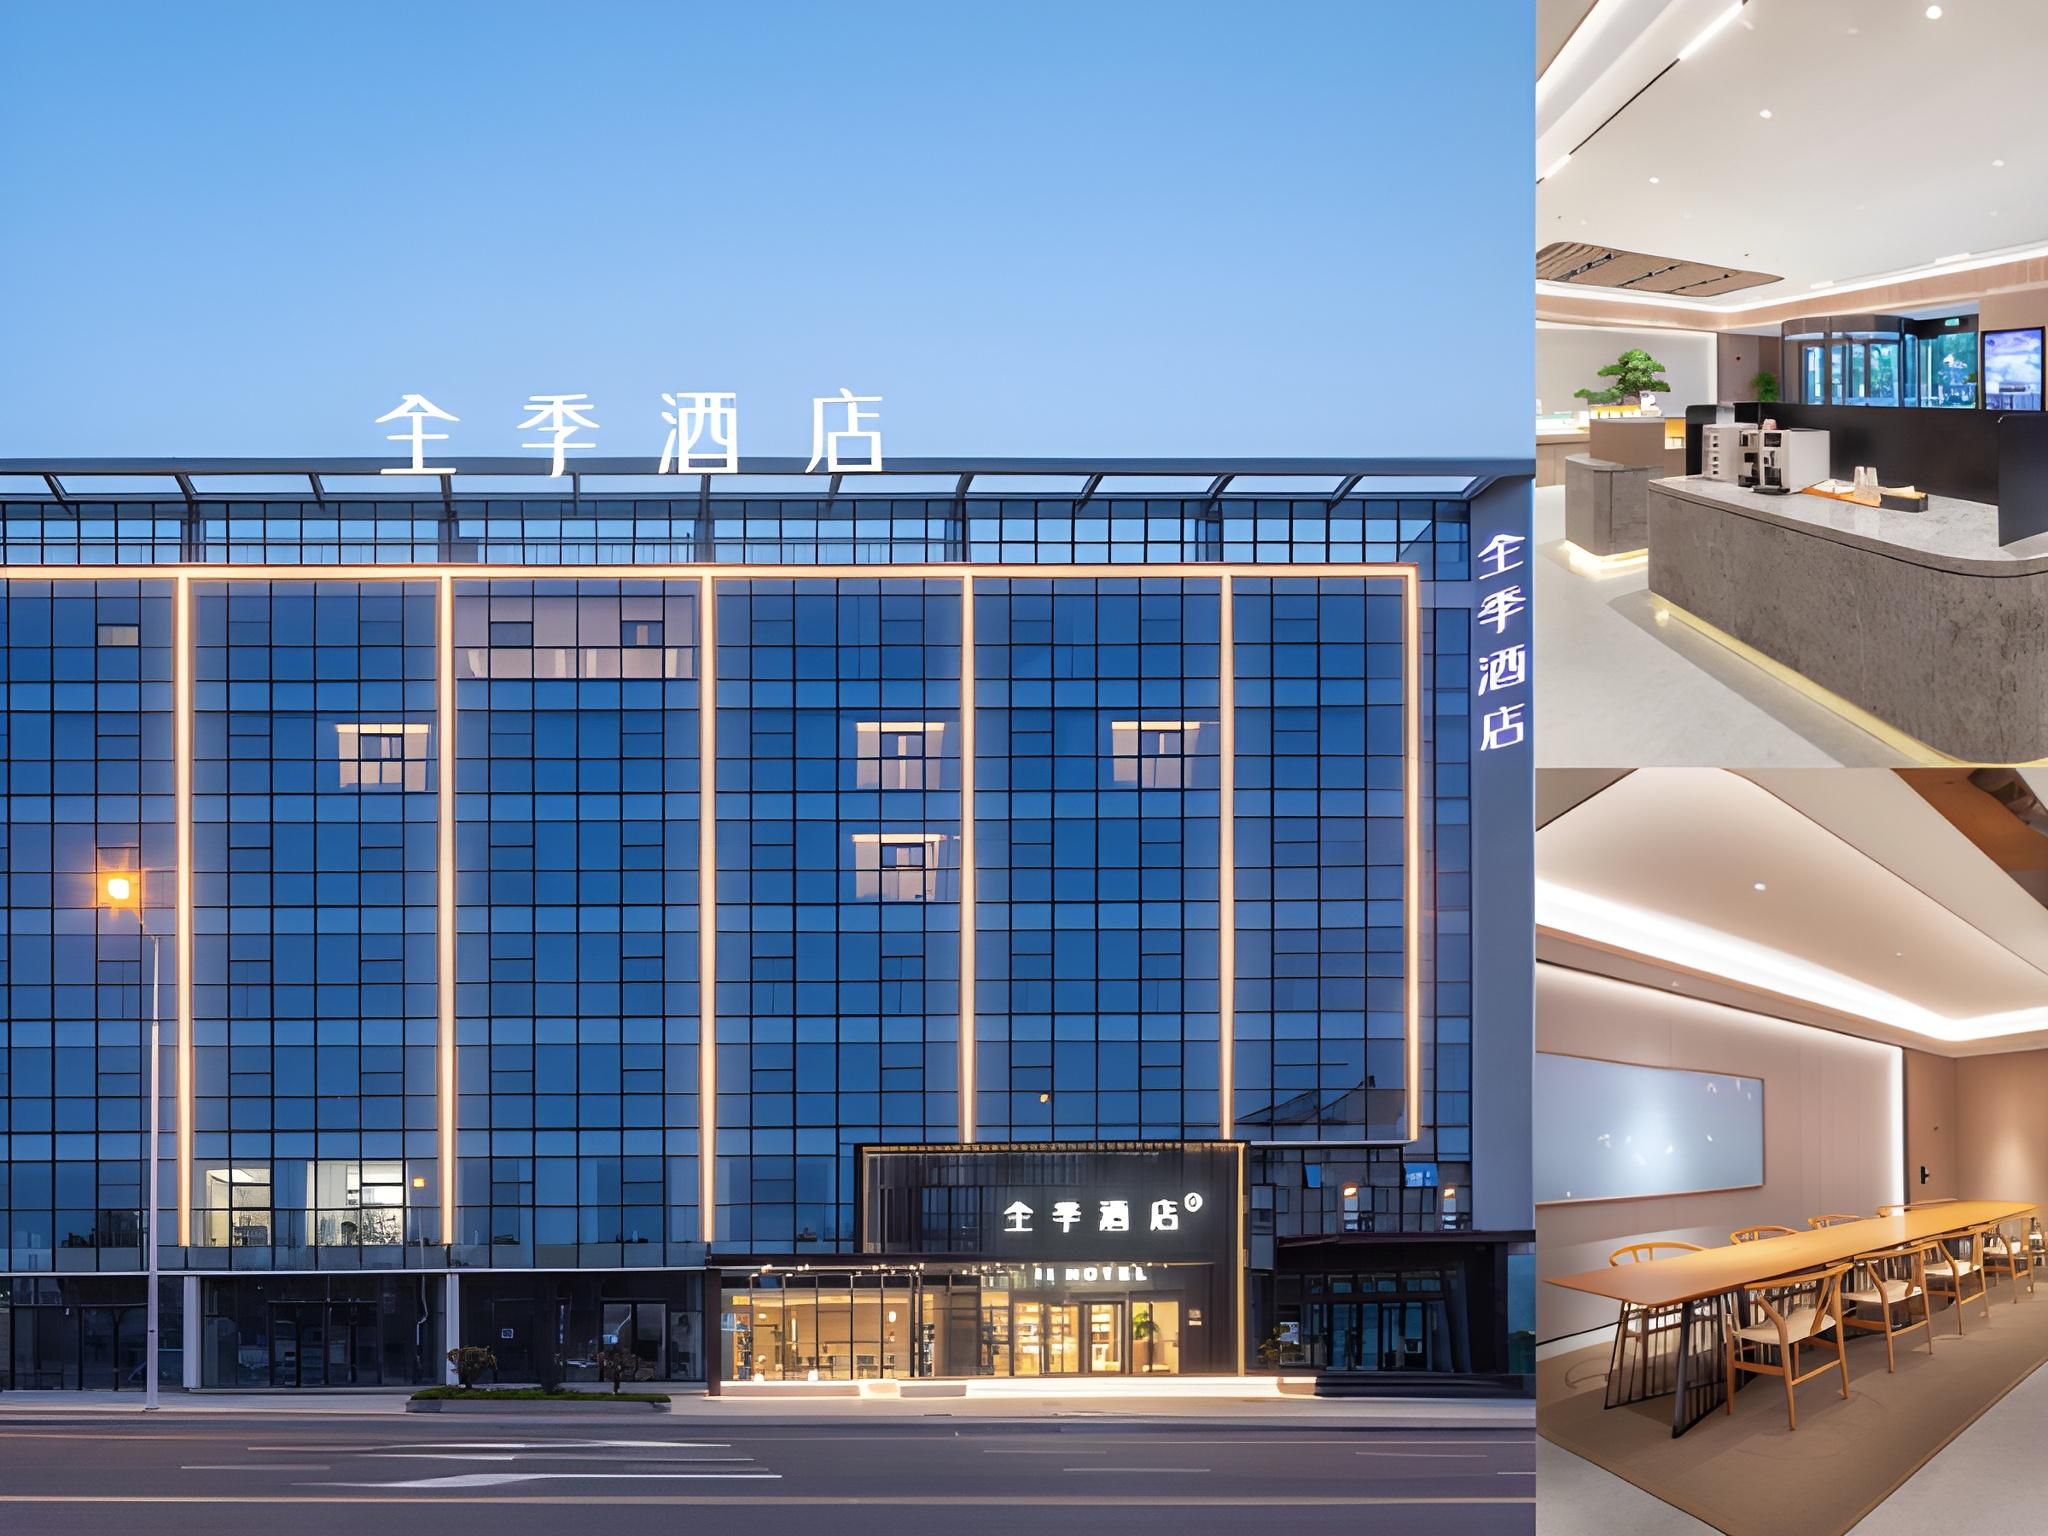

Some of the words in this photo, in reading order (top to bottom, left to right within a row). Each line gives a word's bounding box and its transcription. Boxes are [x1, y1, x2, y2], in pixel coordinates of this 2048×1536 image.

[376, 388, 884, 478] 全季酒店
[1477, 533, 1527, 752] 全季酒店
[1003, 1198, 1179, 1233] 全季酒店
[1065, 1266, 1148, 1282] HOTEL
